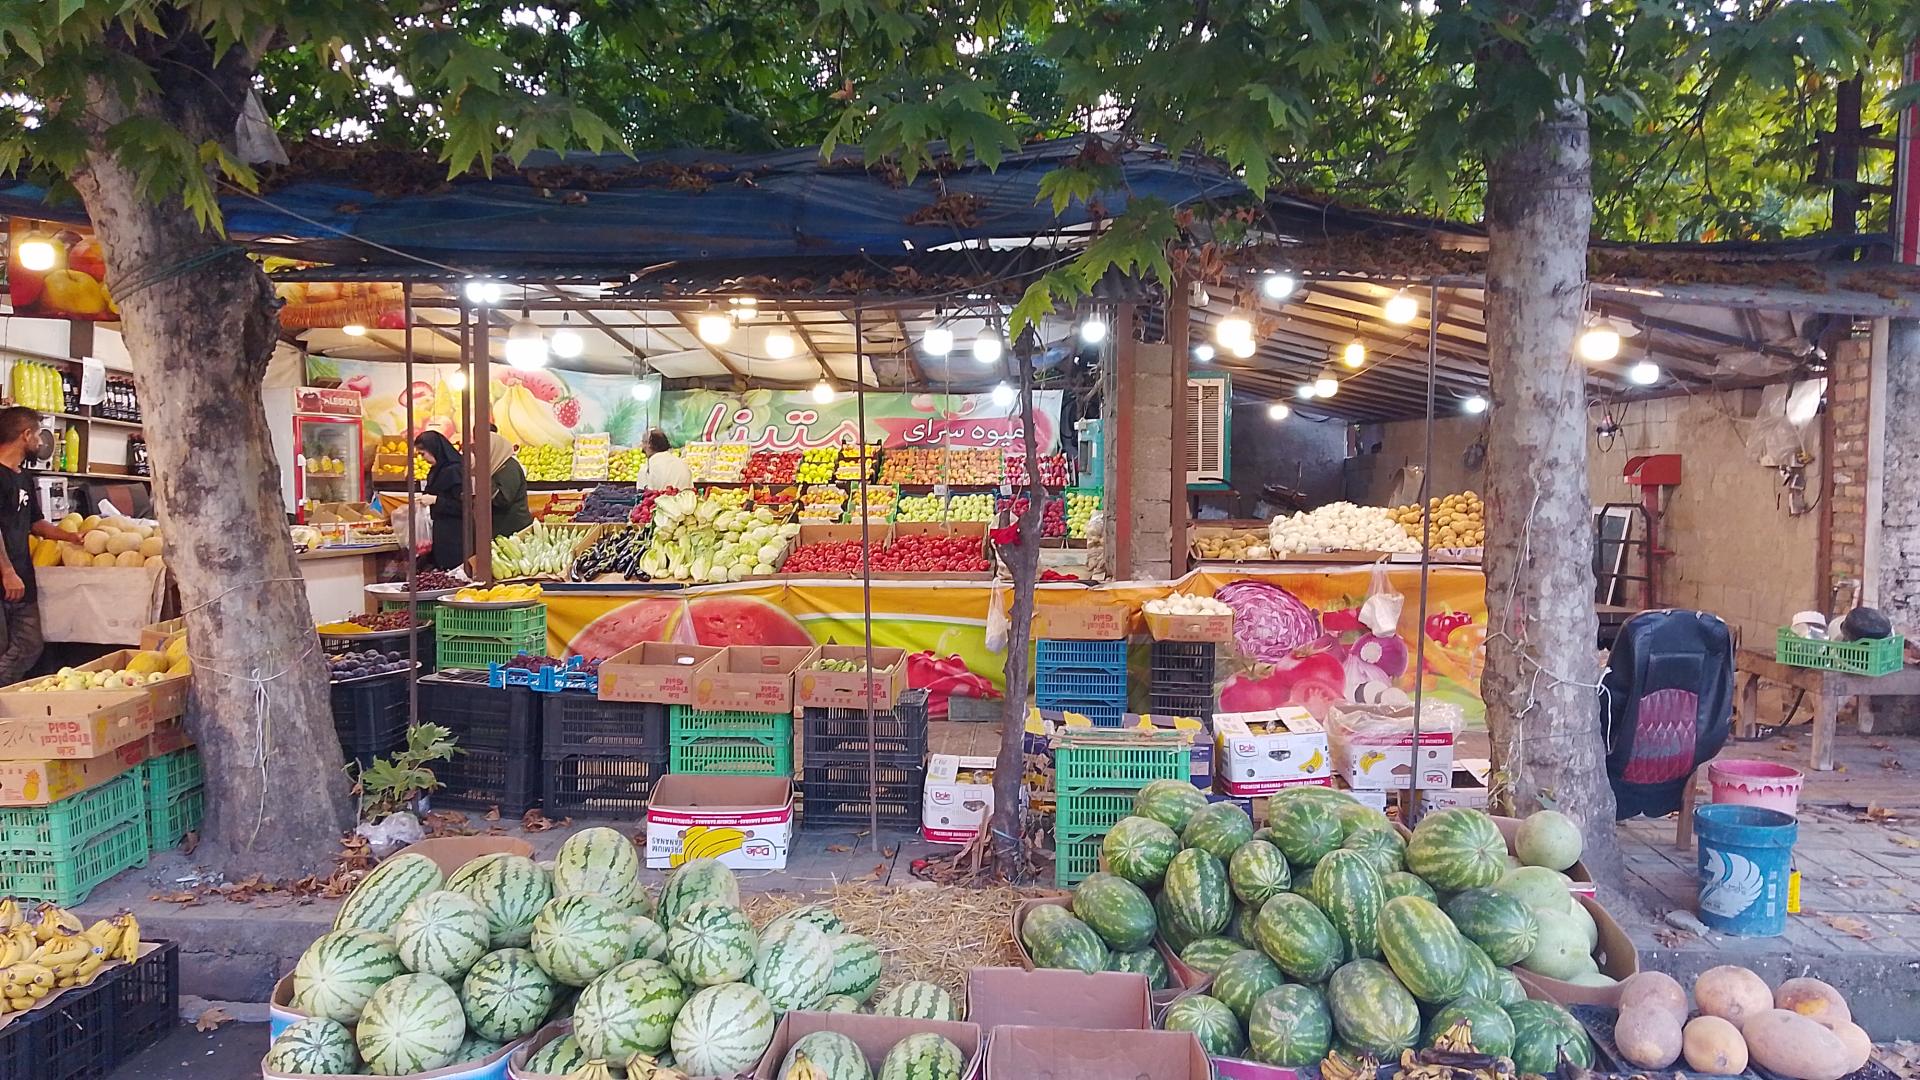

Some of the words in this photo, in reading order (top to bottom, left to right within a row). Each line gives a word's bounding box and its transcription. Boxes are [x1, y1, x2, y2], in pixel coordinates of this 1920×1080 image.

[903, 417, 966, 444] سرای
[971, 426, 1025, 448] میوه
[48, 721, 81, 734] Gold
[40, 733, 91, 746] Tropical
[652, 845, 683, 853] PREMIUM
[746, 847, 770, 857] Dole
